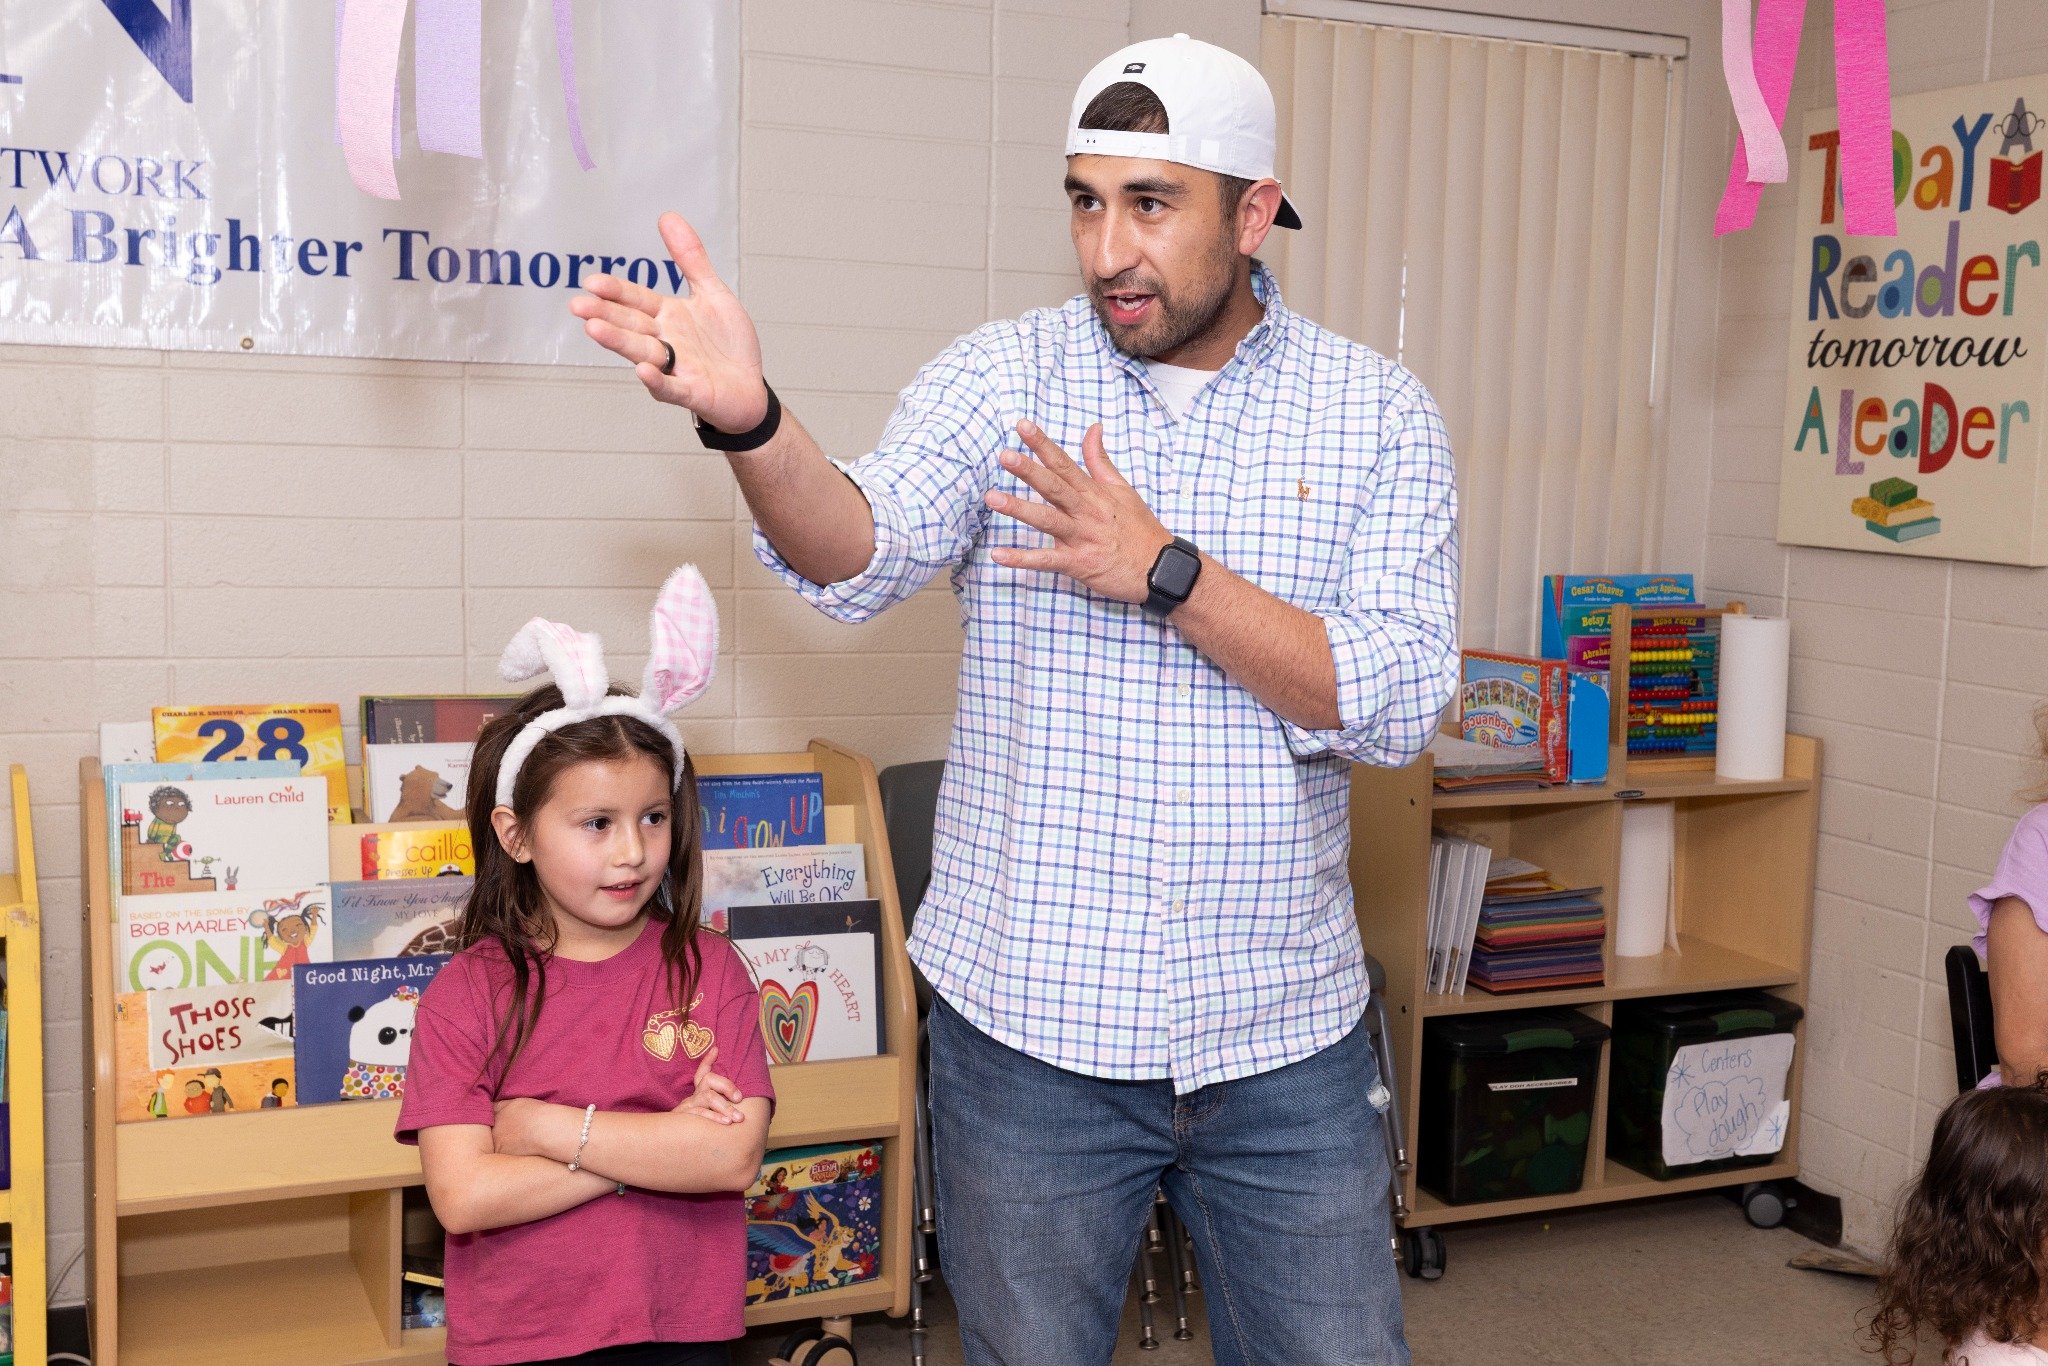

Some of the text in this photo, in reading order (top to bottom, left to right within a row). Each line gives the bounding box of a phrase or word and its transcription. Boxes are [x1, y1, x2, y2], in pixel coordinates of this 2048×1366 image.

[0, 147, 208, 200] TWORK
[0, 204, 44, 260] A
[66, 209, 363, 286] Brighter
[1808, 220, 2041, 321] Reader
[1806, 329, 2029, 369] tomorrow
[1794, 385, 1829, 454] A
[1582, 615, 1605, 627] Betsy
[1462, 713, 1515, 741] Sequence
[198, 718, 309, 769] 28
[215, 786, 304, 805] Lauren Child
[790, 792, 822, 836] UP
[406, 833, 474, 862] caillo
[140, 872, 176, 889] The
[385, 867, 417, 877] Dresses
[761, 859, 855, 890] Everything
[363, 895, 397, 908] Know
[403, 893, 427, 909] You
[770, 889, 794, 904] Will
[800, 889, 815, 903] Be
[130, 911, 161, 921] BASED
[185, 909, 201, 918] THE
[206, 908, 233, 917] SONG
[237, 906, 249, 914] BY
[395, 909, 438, 920] MY LOVE
[130, 918, 250, 938] BOB MARLEY
[305, 963, 434, 985] Good Night, Mr.
[765, 948, 790, 965] MY
[829, 968, 861, 1022] HEART
[162, 1025, 242, 1065] SHOES
[1702, 1048, 1752, 1073] Centers
[1526, 1080, 1573, 1088] ACCESSORIES
[1694, 1087, 1728, 1118] Play
[1709, 1093, 1760, 1147] dough
[812, 1162, 837, 1174] ELENA
[863, 1158, 872, 1166] 64
